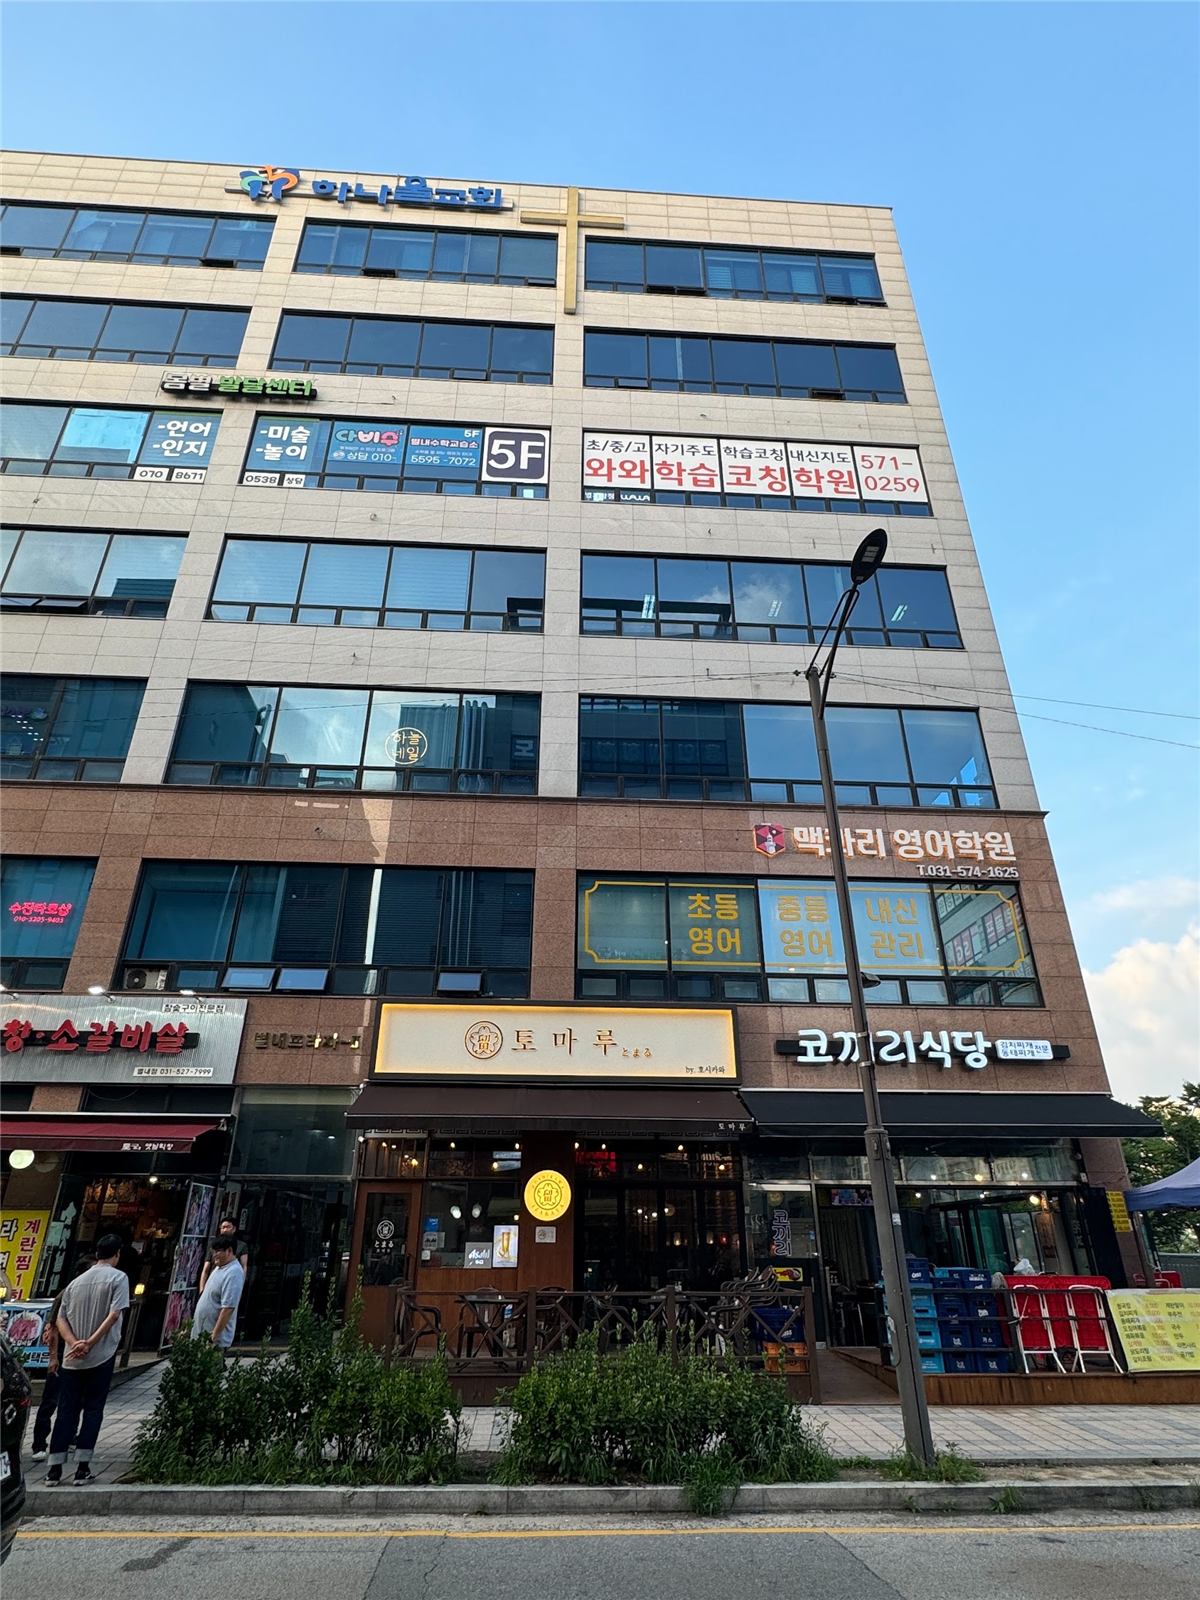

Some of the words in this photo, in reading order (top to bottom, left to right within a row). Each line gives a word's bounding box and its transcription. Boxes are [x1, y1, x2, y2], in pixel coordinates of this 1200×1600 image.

[218, 375, 313, 396] 발달센터
[463, 429, 480, 438] 5F
[410, 438, 479, 449] 별내수학교습소
[586, 439, 648, 454] 초/중/고
[654, 442, 717, 457] 자기주도
[411, 455, 440, 464] 5595
[488, 439, 545, 470] 5F
[723, 445, 785, 462] 학습코칭
[789, 448, 851, 464] 내신지도
[861, 454, 913, 471] 571-
[138, 470, 164, 478] 070
[175, 471, 204, 480] 8671
[245, 475, 278, 484] 0538
[865, 475, 920, 494] 0259
[391, 730, 422, 745] 하늘
[892, 828, 1017, 862] 영어학원
[916, 864, 1019, 878] T.031-574-1625
[688, 893, 739, 920] 초등
[777, 895, 829, 922] 중등
[865, 897, 919, 925] 내신
[688, 927, 742, 955] 영어
[779, 929, 833, 958] 영어
[870, 931, 925, 959] 관리
[621, 1047, 653, 1058] とまる
[796, 1028, 992, 1069] 코끼리식당
[771, 1209, 792, 1257] 코끼리
